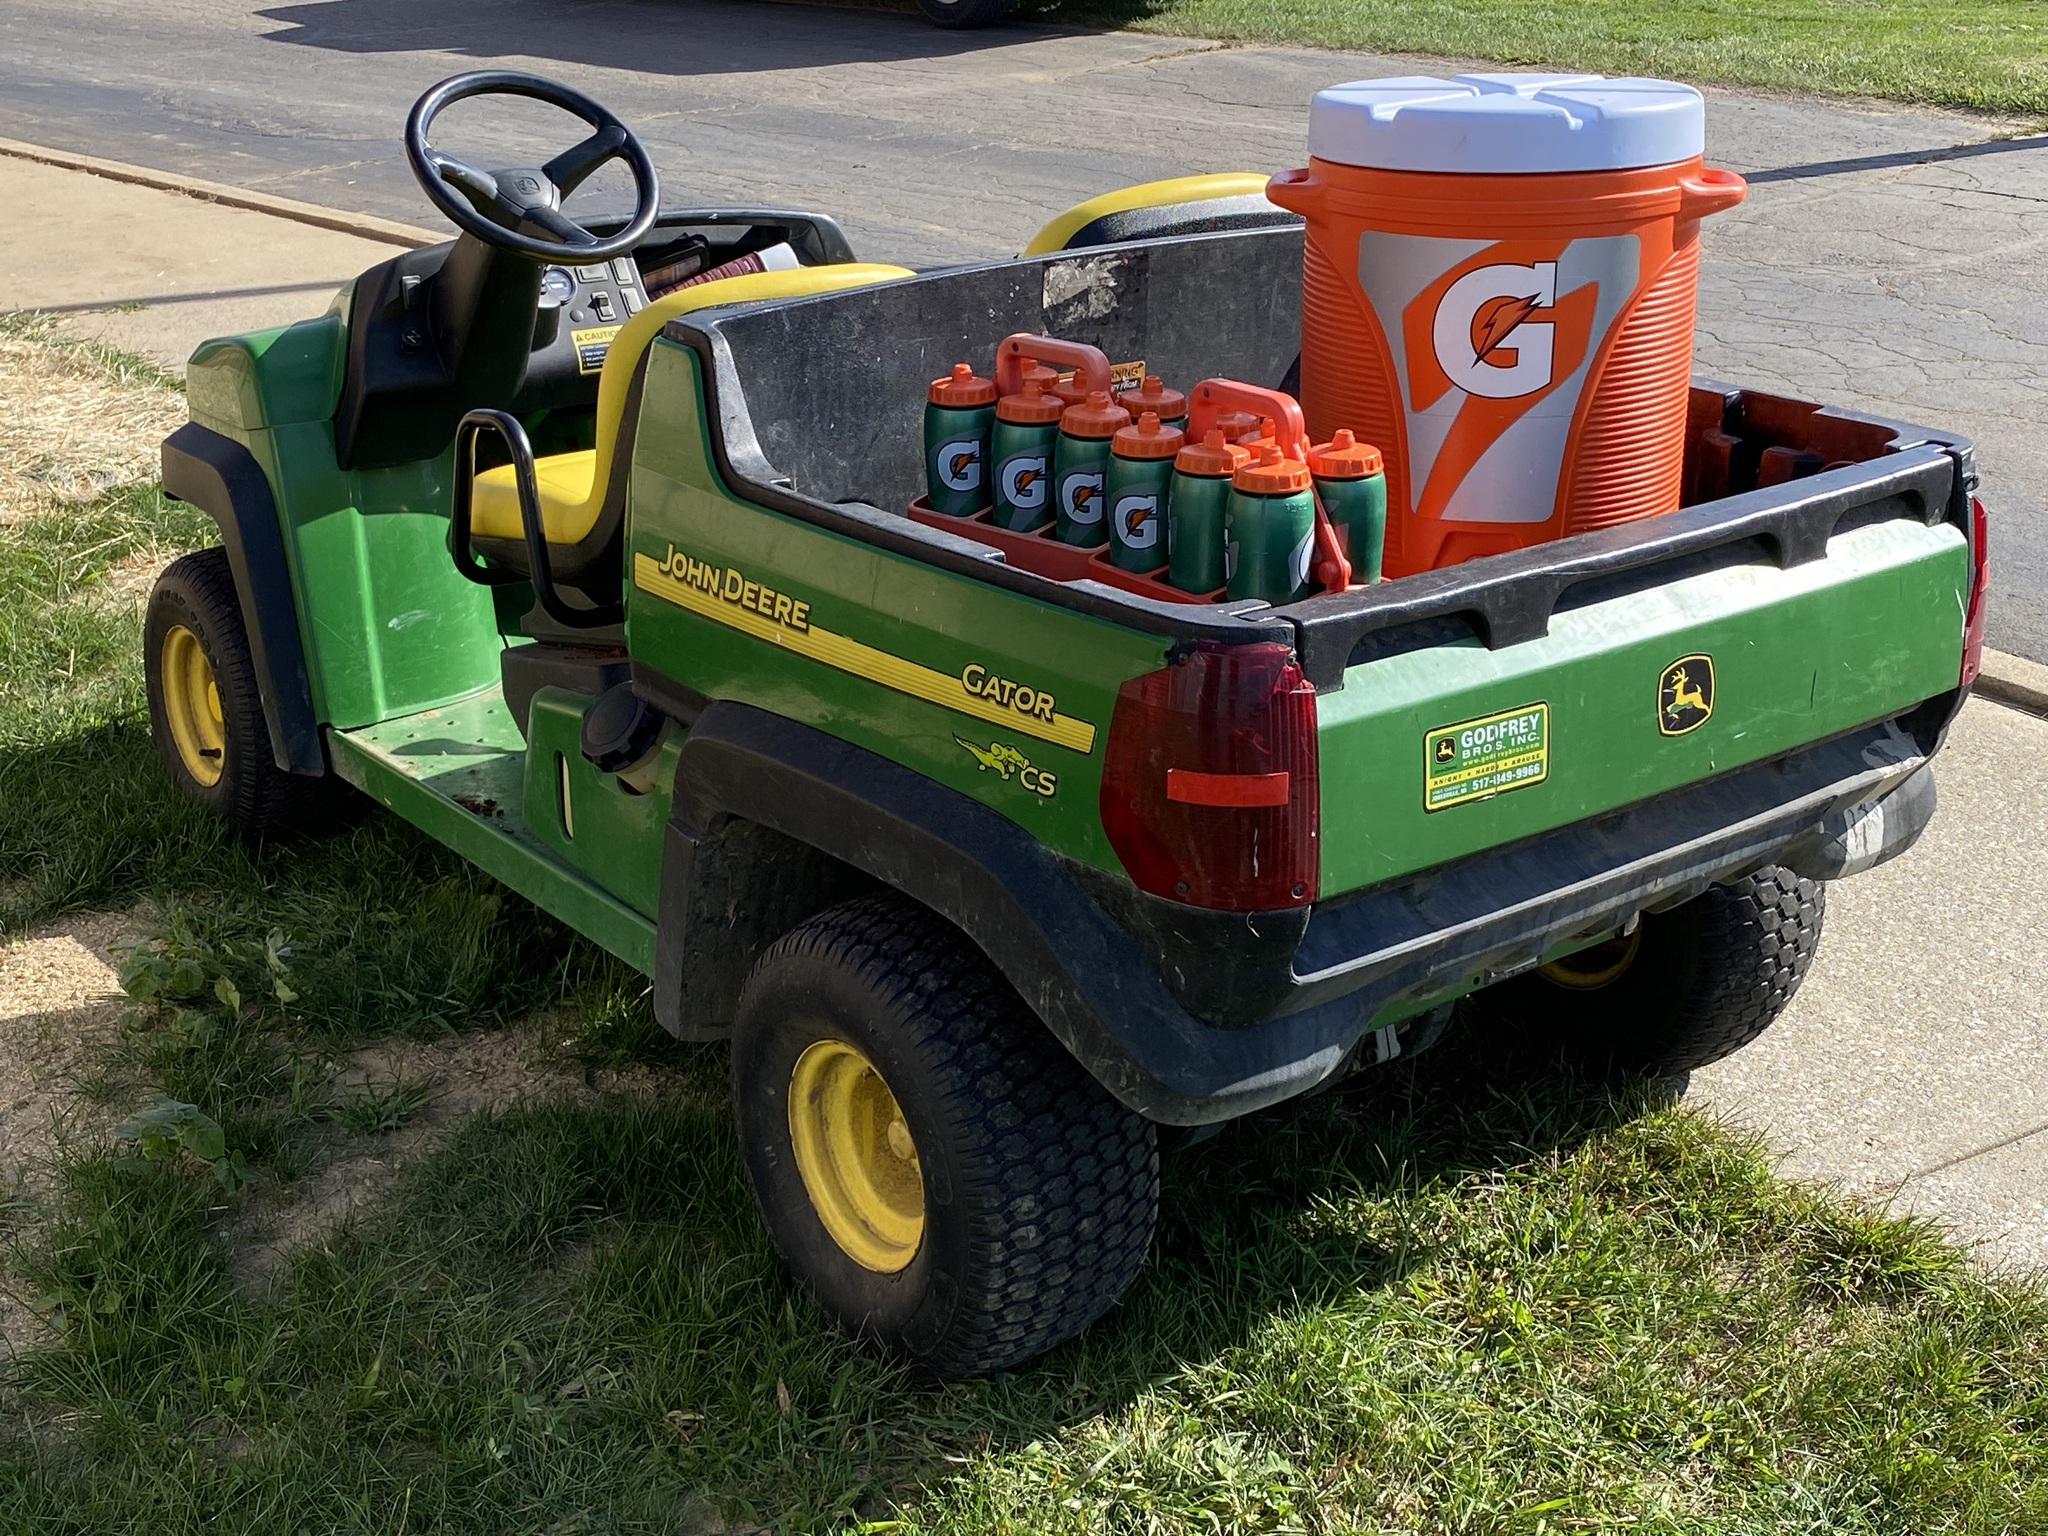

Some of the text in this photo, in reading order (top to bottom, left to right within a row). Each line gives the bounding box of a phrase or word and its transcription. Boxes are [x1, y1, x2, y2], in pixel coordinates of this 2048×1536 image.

[584, 331, 618, 341] CAUTIO
[1432, 260, 1558, 398] G
[937, 440, 980, 491] G
[1001, 456, 1046, 508] G
[1061, 472, 1105, 524] G
[1115, 495, 1158, 549] G
[658, 544, 811, 633] JOHN DEERE
[962, 663, 1056, 722] GATOR
[1462, 713, 1540, 748] GODFREY
[1462, 732, 1540, 760] BROS. INC.
[1019, 765, 1057, 797] CS
[1433, 774, 1462, 786] KNIGHT
[1512, 754, 1540, 765] KRAUSE
[1472, 763, 1540, 791] 517-849-9966
